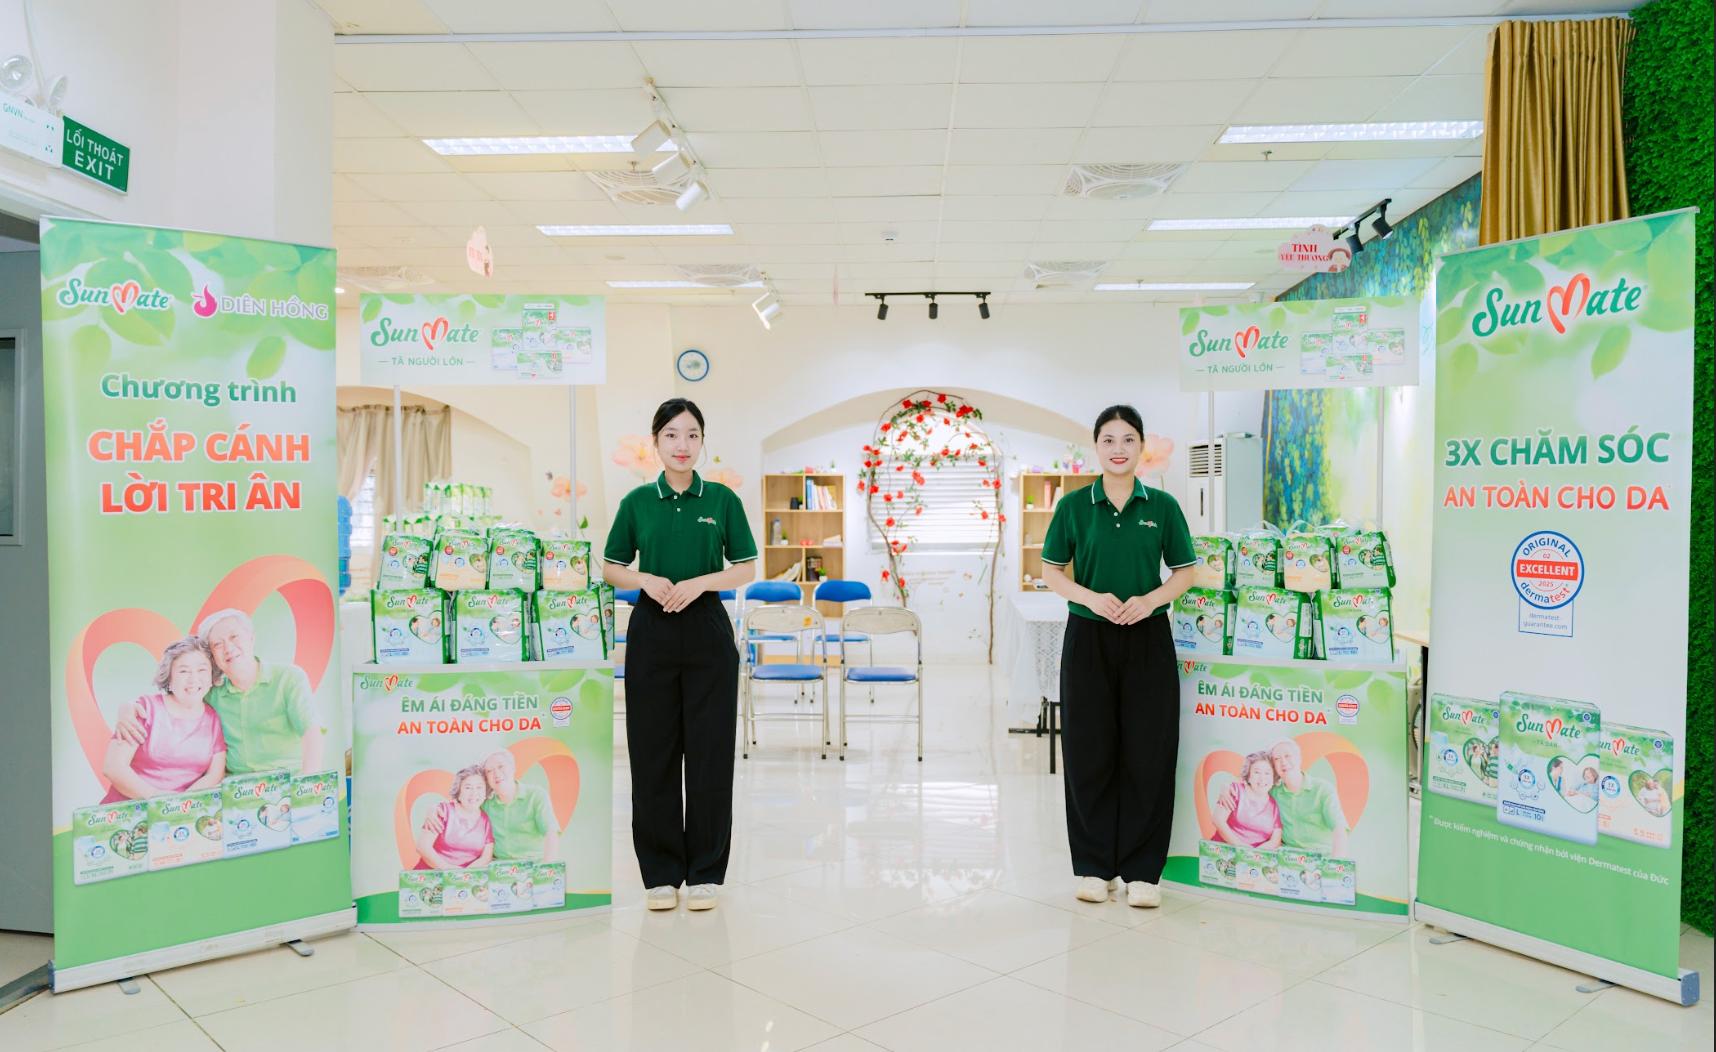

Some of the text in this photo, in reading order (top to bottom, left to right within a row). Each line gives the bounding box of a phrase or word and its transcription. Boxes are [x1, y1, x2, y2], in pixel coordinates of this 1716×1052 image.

[66, 129, 85, 149] LỐI
[87, 139, 124, 166] THOÁT
[74, 150, 114, 180] EXIT
[222, 293, 328, 319] DIÊN HỒNG
[101, 374, 296, 406] Chương trình
[88, 419, 310, 461] CHẮP CÁNH
[1445, 425, 1670, 466] 3X CHĂM SÓC
[101, 472, 300, 513] LỜI TRI ÂN
[1443, 486, 1475, 507] AN
[1482, 480, 1549, 508] TOÀN
[1557, 486, 1616, 510] CHO
[1522, 537, 1571, 558] ORIGINAL
[1519, 563, 1575, 576] EXCELLENT
[1520, 582, 1571, 603] dermatest
[401, 692, 538, 713] ÊM ÁI ĐÁNG TIỀN
[1197, 679, 1323, 703] ÊM ÁI ĐÁNG TIỀN
[1195, 703, 1215, 715] AN
[1220, 702, 1260, 720] TOÀN
[1265, 707, 1299, 723] CHO
[397, 721, 422, 734] AN
[427, 718, 473, 734] TOÀN
[478, 718, 514, 733] CHO
[1589, 857, 1632, 876] Dermatest
